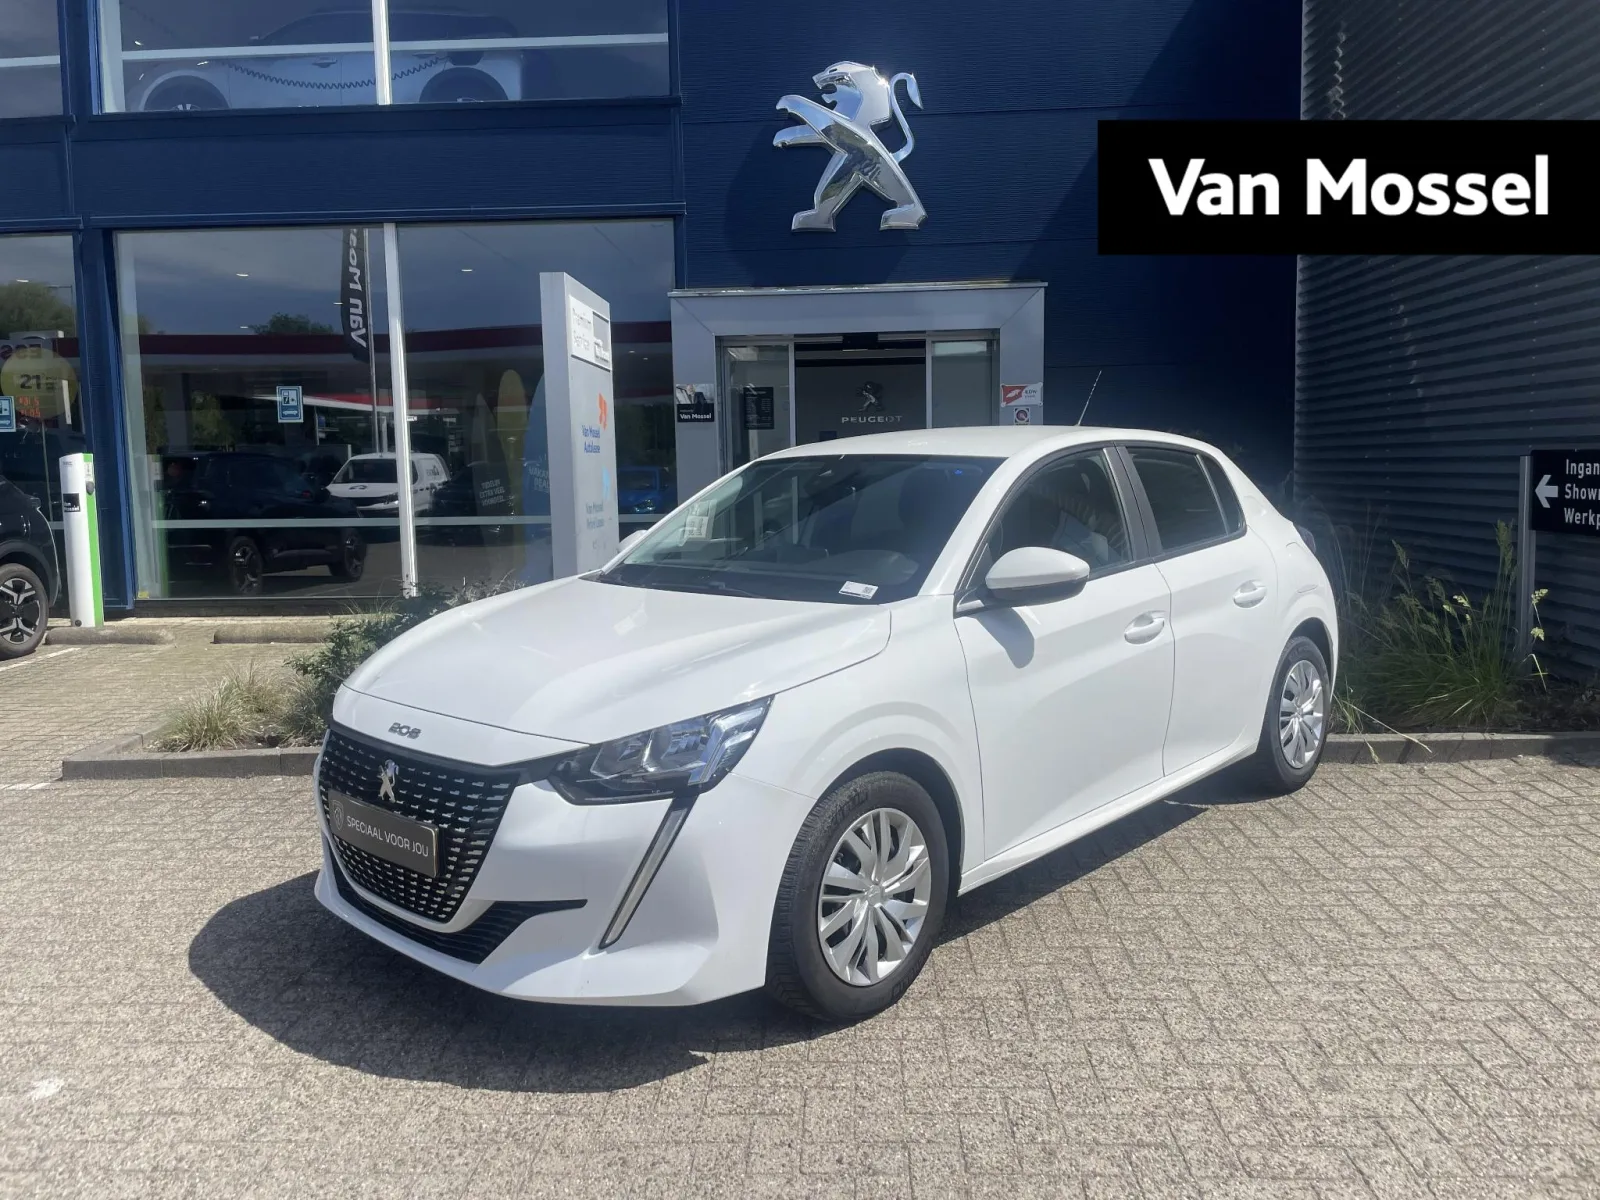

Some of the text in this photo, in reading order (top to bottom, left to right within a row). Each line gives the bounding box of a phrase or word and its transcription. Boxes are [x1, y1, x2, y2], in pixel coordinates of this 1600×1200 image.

[841, 415, 902, 424] PEUGEOT
[388, 721, 422, 740] 208
[346, 815, 429, 857] SPECIAAL VOOR JOU
